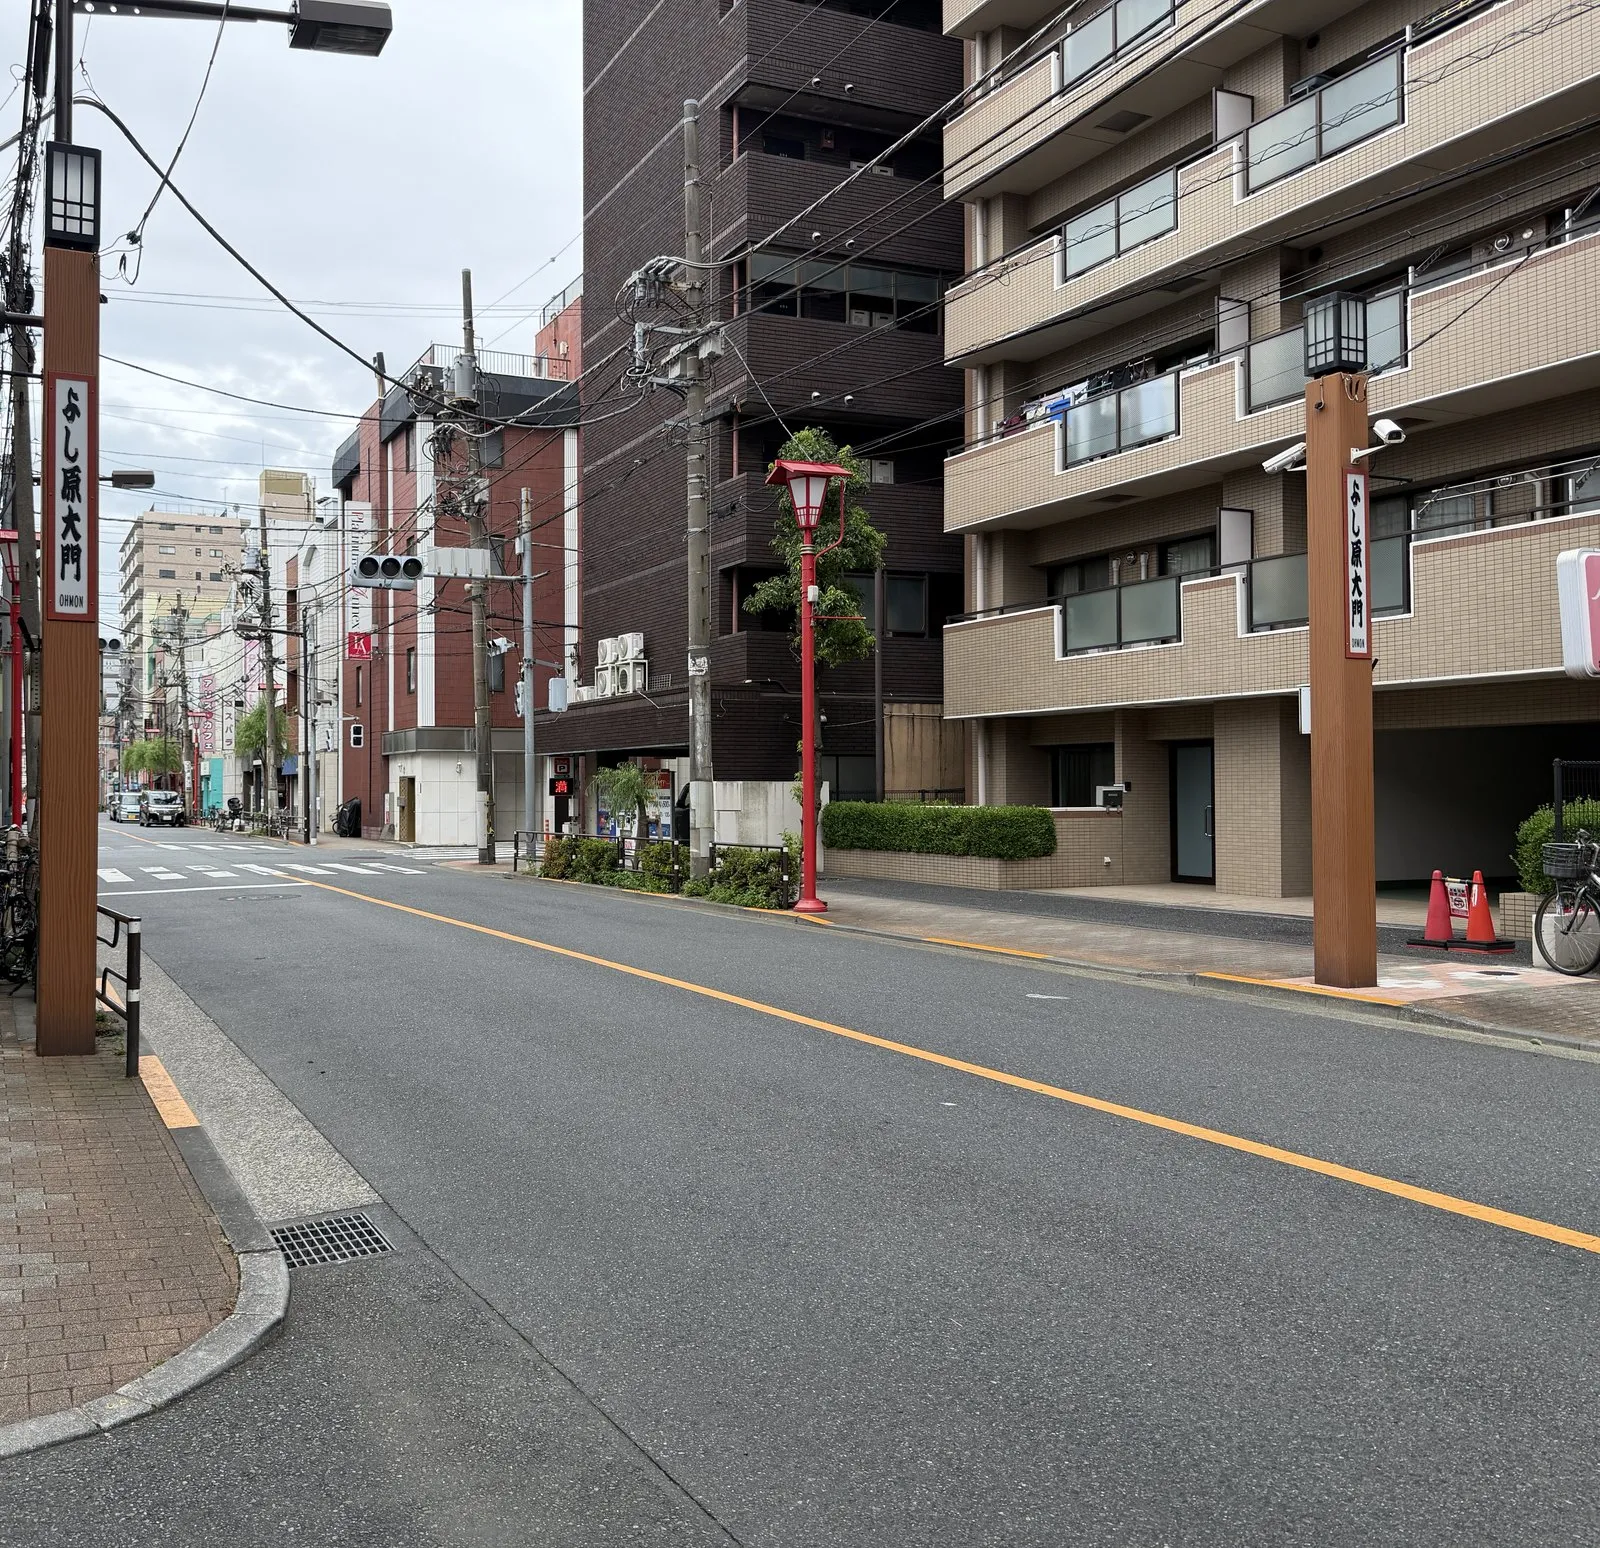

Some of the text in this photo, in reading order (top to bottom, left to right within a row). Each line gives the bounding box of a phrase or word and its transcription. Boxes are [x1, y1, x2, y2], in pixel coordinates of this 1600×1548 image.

[61, 387, 82, 582] よし原大門
[1351, 480, 1363, 628] よし原大門
[59, 593, 84, 608] OHMON
